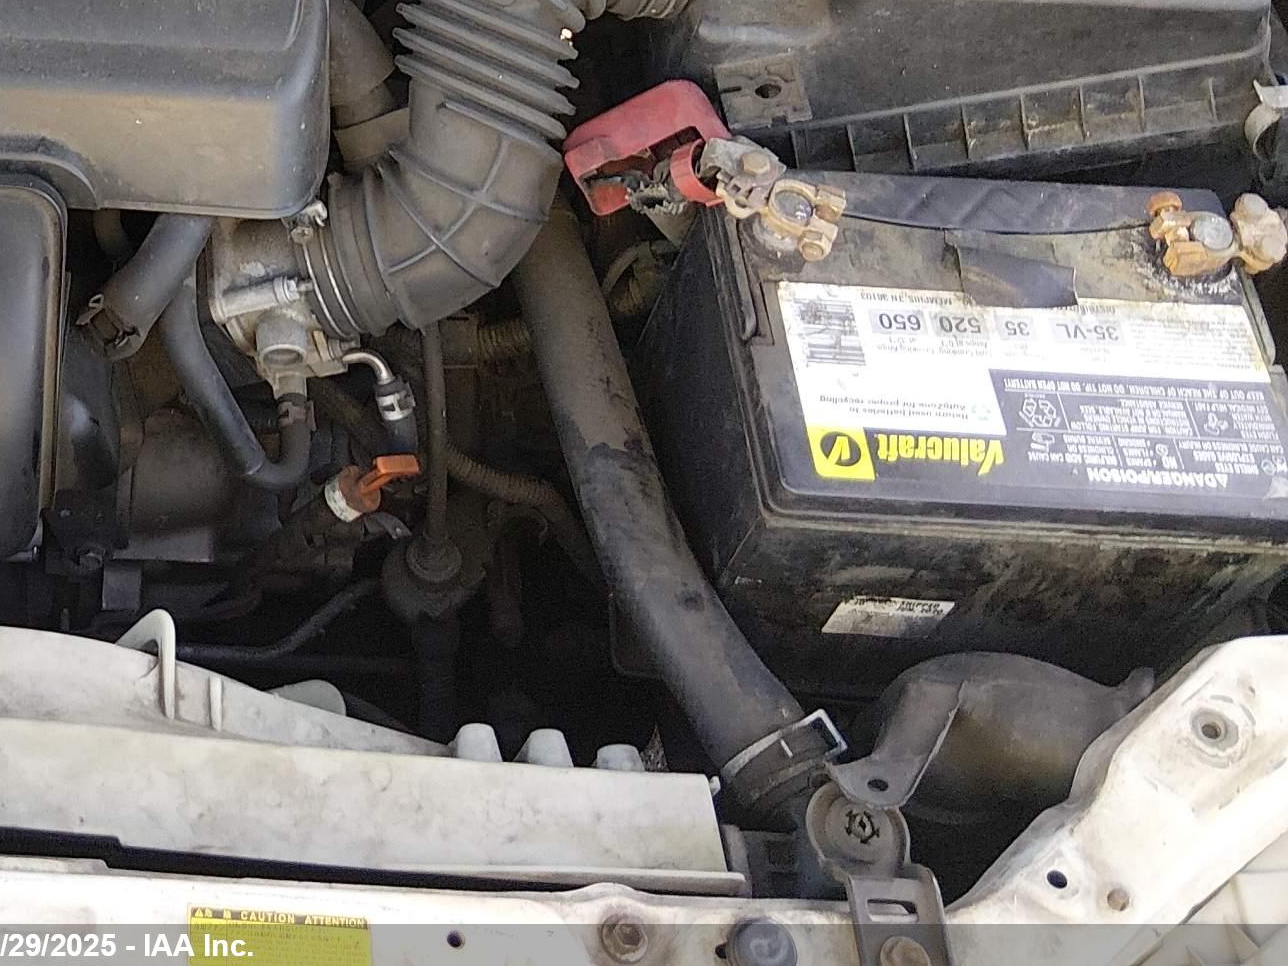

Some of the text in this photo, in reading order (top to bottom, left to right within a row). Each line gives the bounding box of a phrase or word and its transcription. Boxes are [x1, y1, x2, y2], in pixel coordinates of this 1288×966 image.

[878, 313, 1119, 341] 35-VL 35 520 650
[1036, 380, 1056, 390] OPEN
[1056, 380, 1070, 390] NOT
[1096, 383, 1112, 393] NOT
[1113, 384, 1124, 394] DO
[1202, 388, 1217, 398] THE
[1230, 390, 1245, 400] OUT
[876, 433, 1004, 476] Valucraft
[1050, 452, 1064, 463] CAN
[1161, 455, 1178, 469] NO
[1214, 462, 1234, 474] EYES
[1086, 466, 1218, 488] DANGER/POISON
[240, 911, 296, 924] CAUTION
[304, 914, 364, 928] ATTENTION
